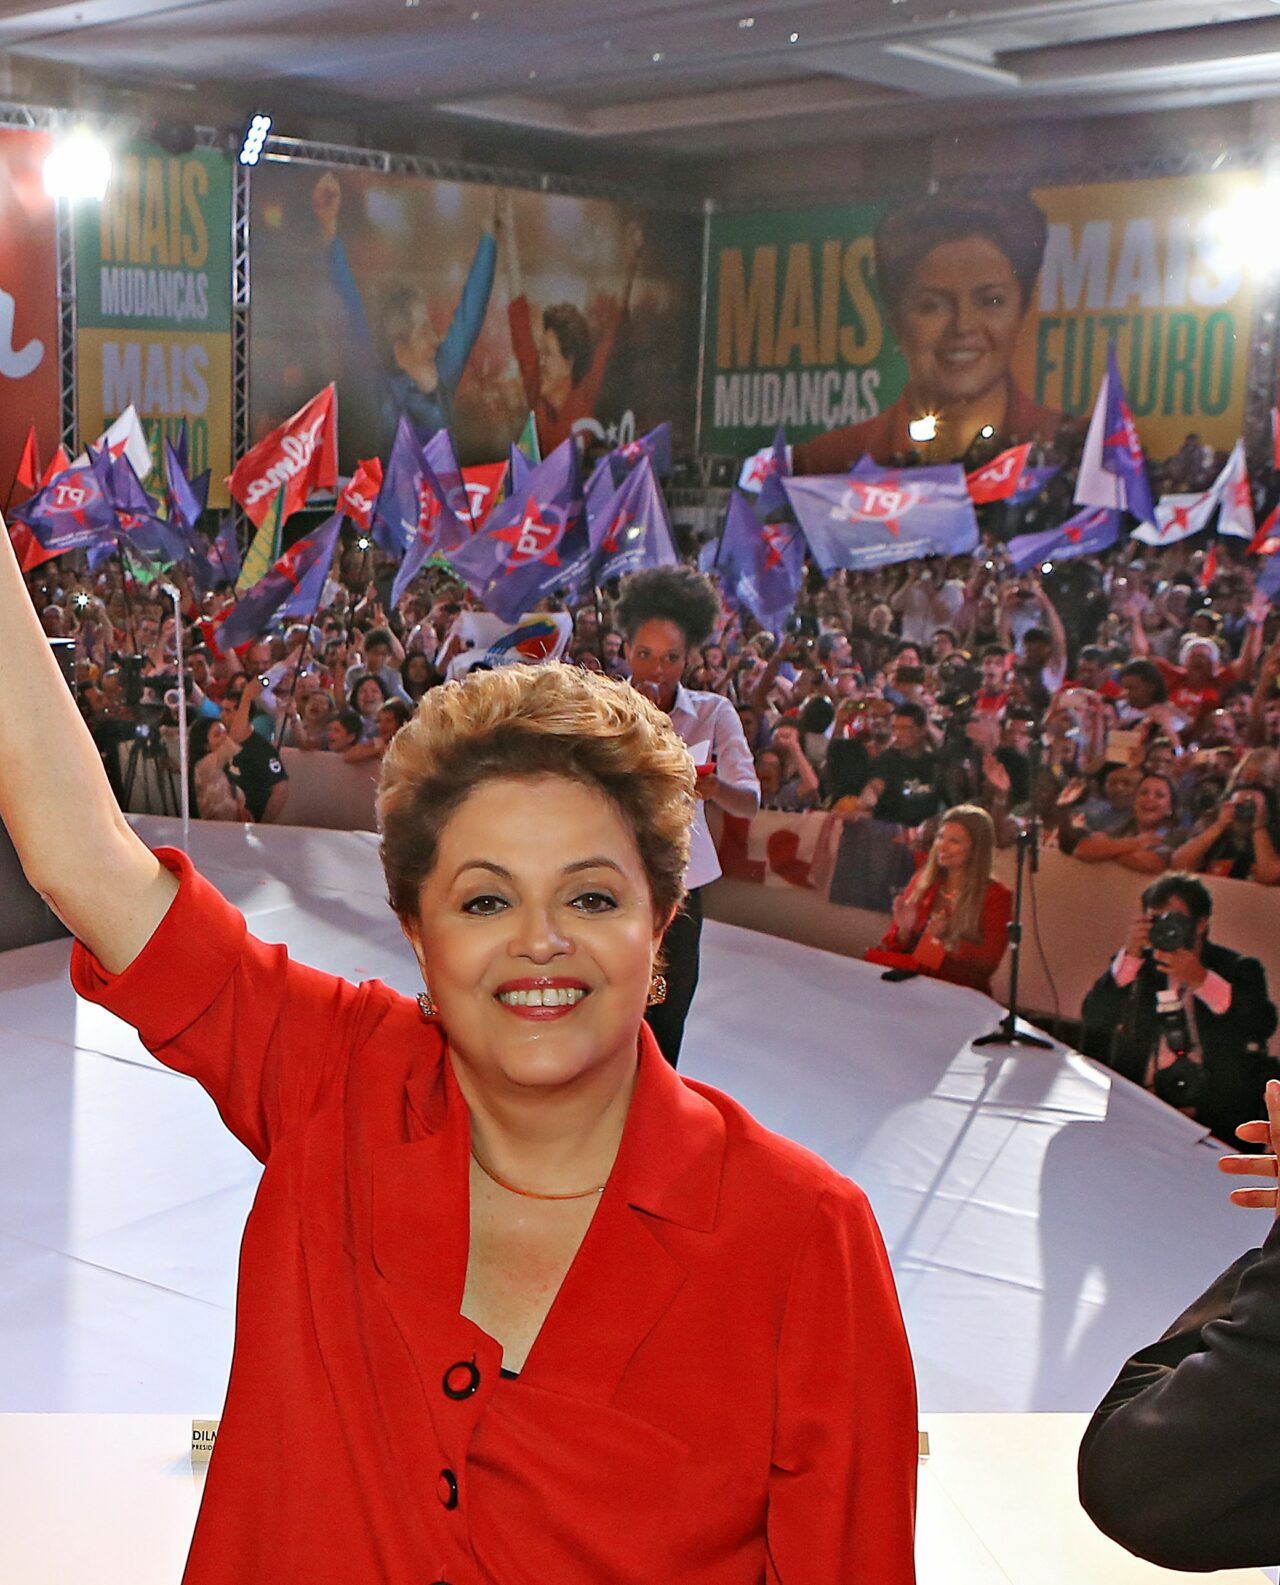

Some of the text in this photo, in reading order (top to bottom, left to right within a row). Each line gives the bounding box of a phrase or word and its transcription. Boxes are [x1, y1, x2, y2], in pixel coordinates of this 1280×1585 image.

[99, 155, 209, 268] MAIS
[100, 266, 209, 324] MUDANÇAS
[1039, 210, 1244, 312] MAIS
[716, 234, 883, 370] MAIS
[102, 342, 210, 416] MAIS
[713, 368, 882, 431] MUDANÇAS
[517, 517, 552, 555] PT
